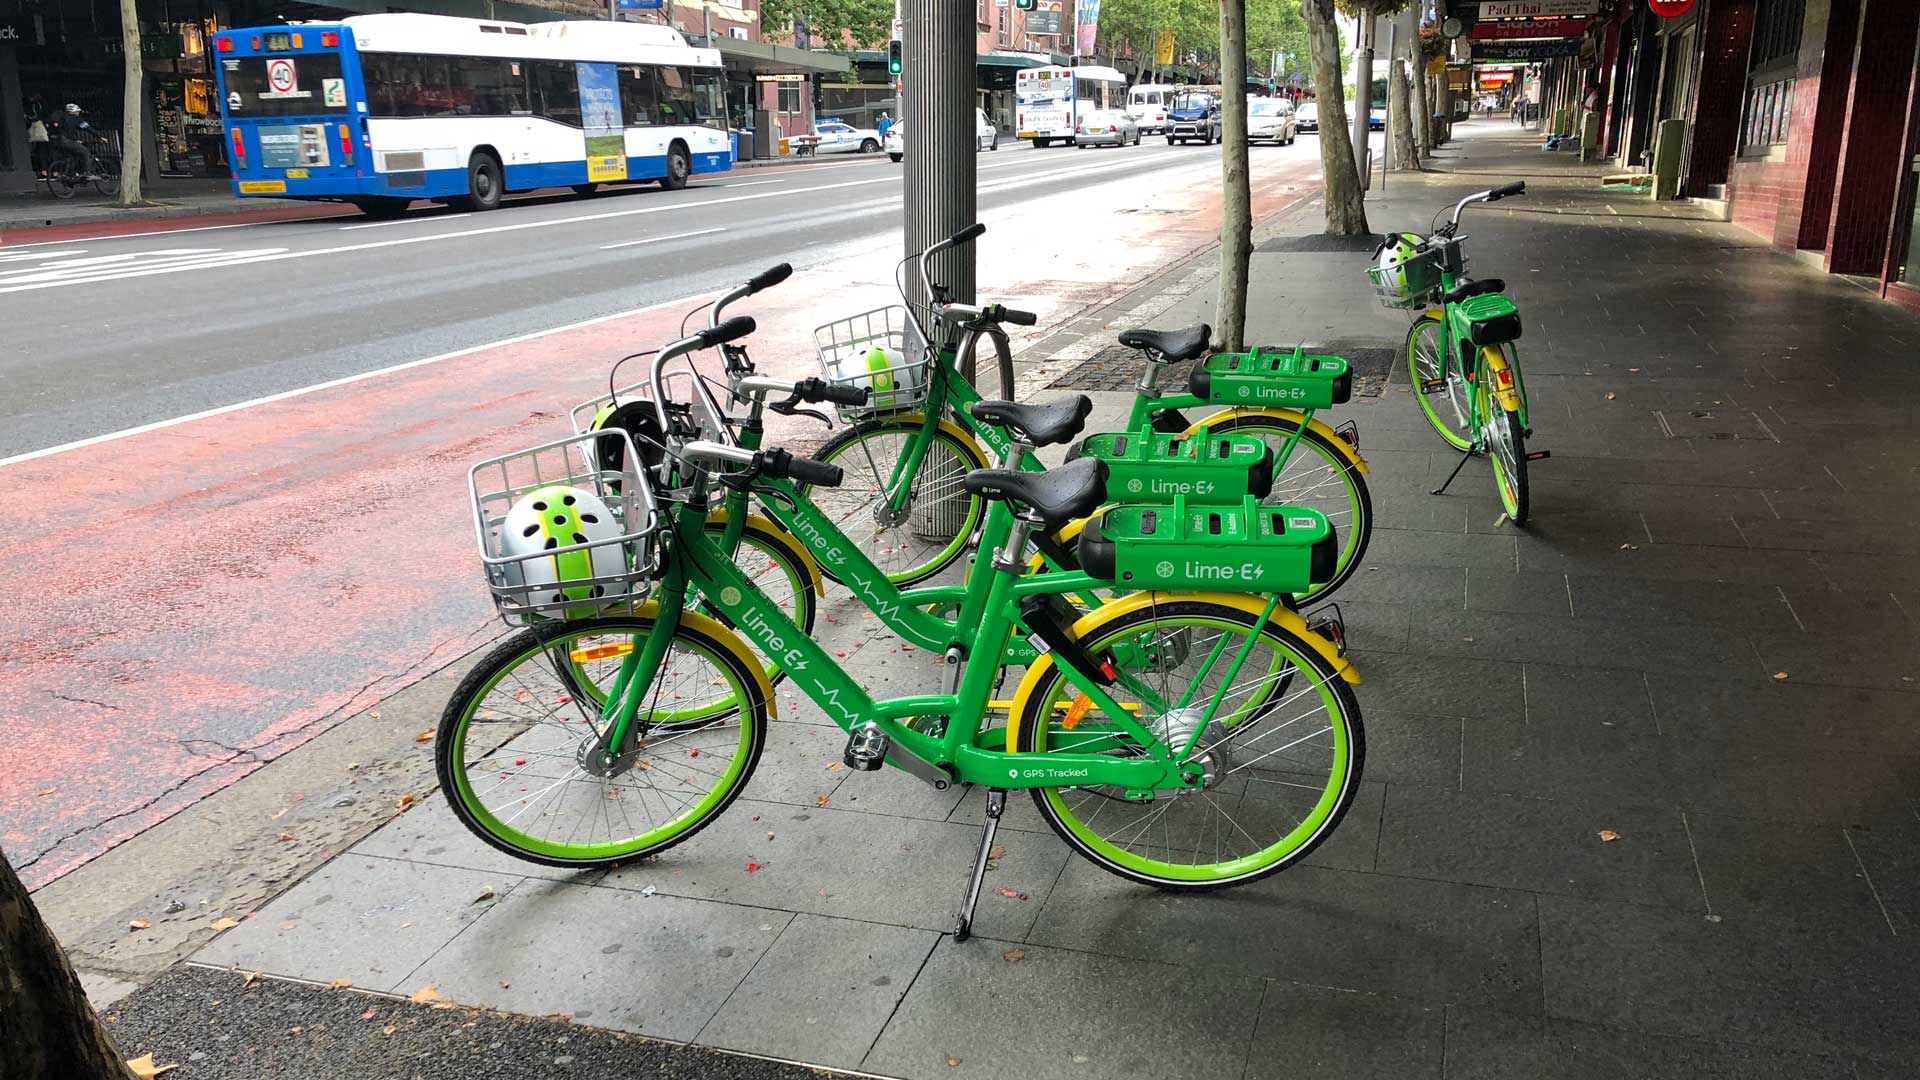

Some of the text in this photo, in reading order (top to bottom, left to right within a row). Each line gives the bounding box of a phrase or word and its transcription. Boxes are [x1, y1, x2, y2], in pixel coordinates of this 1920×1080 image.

[1487, 4, 1510, 15] Pad
[1514, 2, 1541, 14] Thai
[1507, 47, 1531, 58] SKYY
[274, 68, 290, 84] 40
[1018, 649, 1036, 657] GPS
[1023, 767, 1088, 778] GPS Tracked
